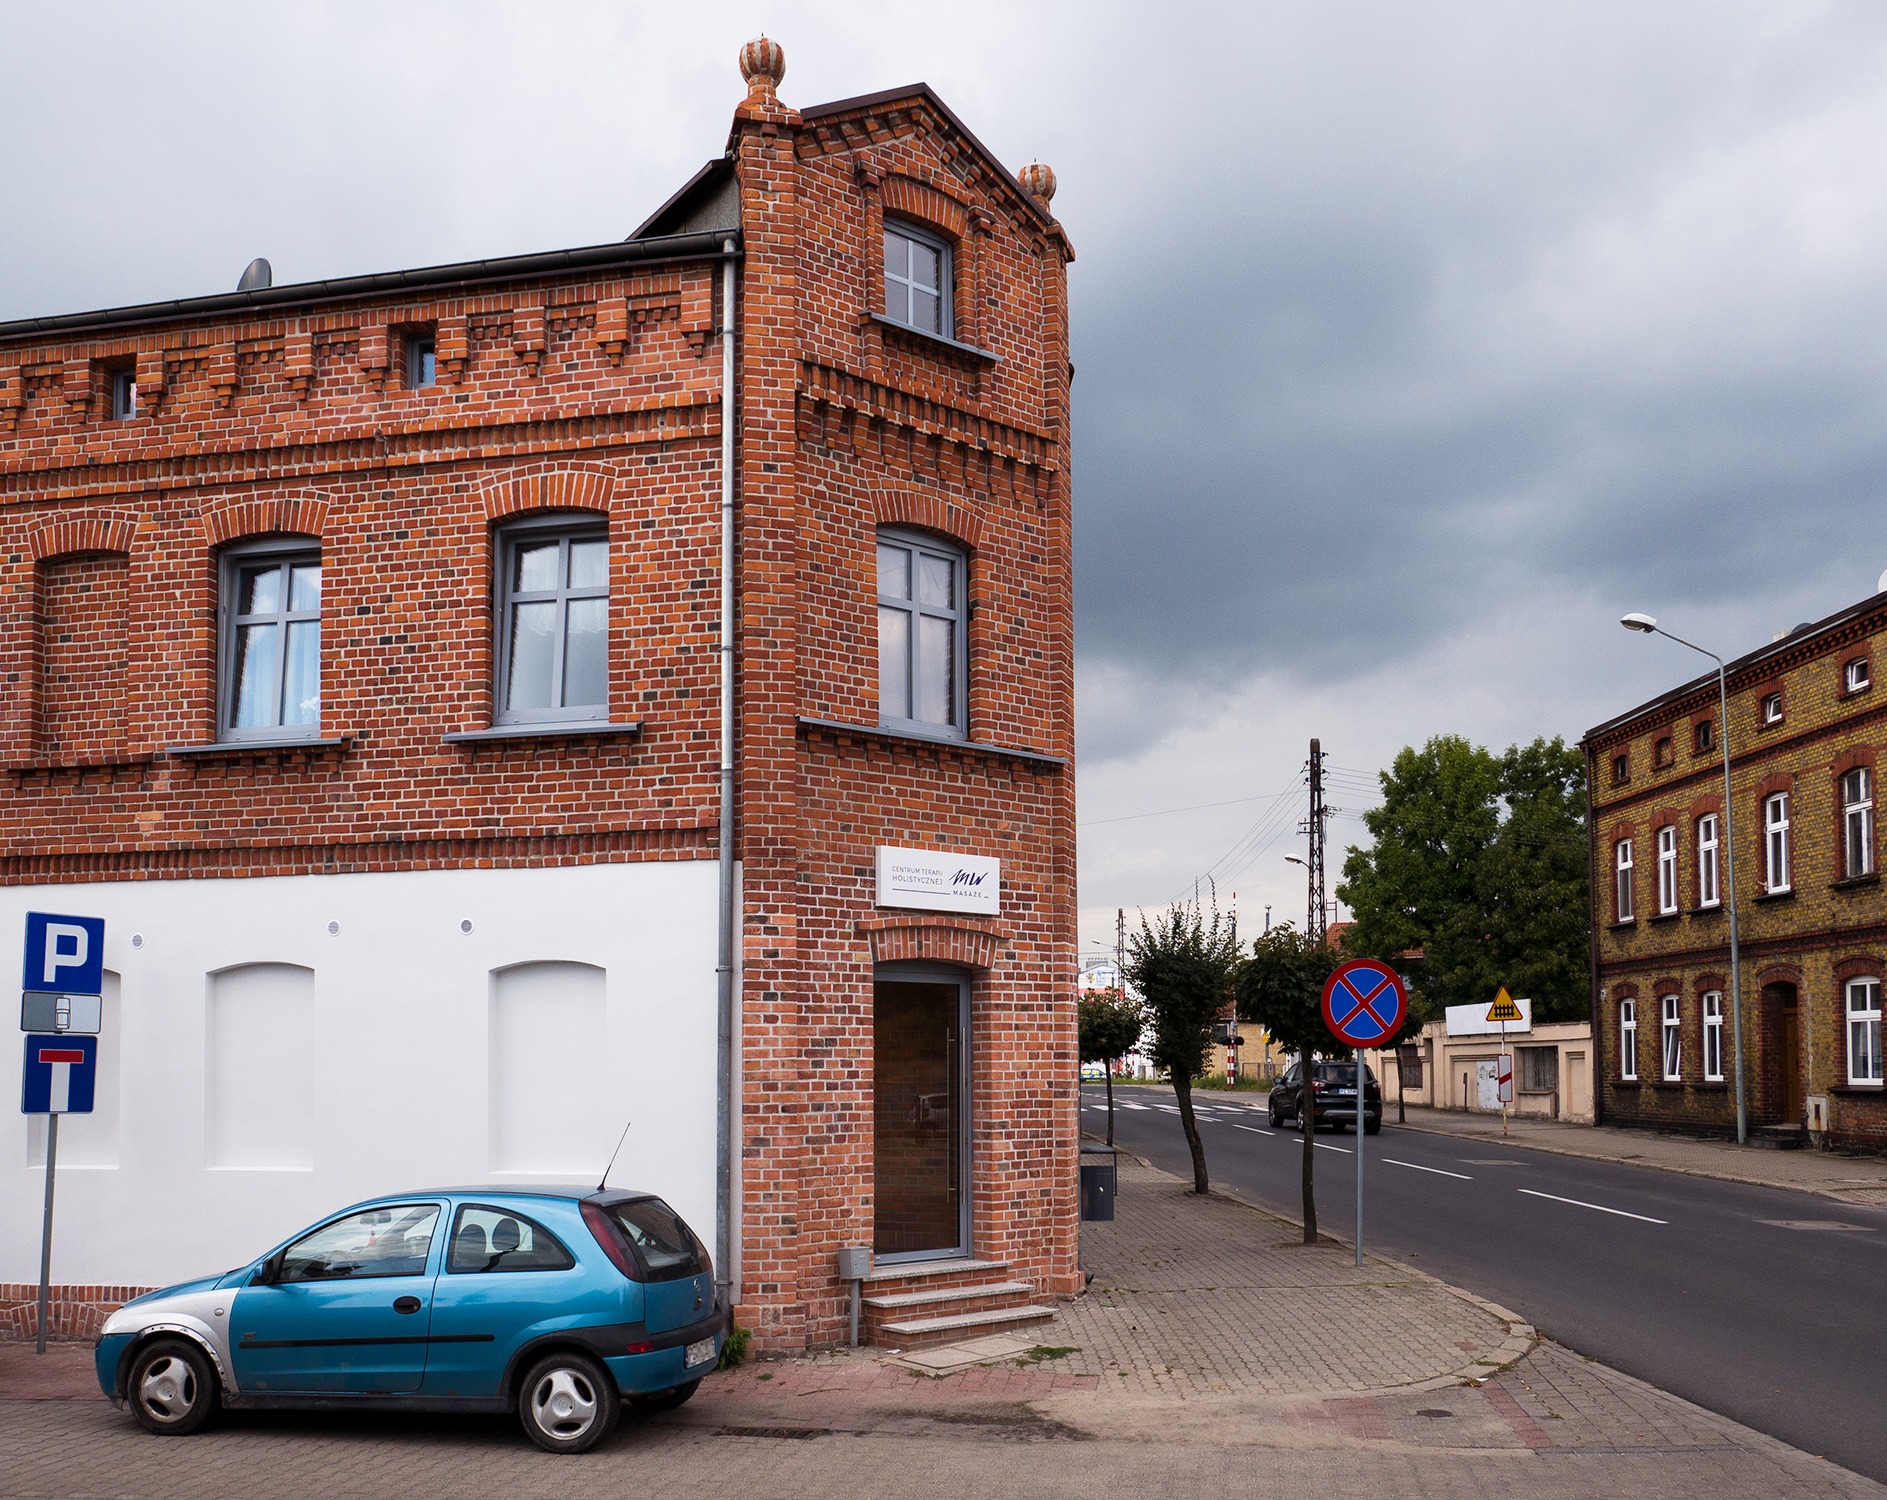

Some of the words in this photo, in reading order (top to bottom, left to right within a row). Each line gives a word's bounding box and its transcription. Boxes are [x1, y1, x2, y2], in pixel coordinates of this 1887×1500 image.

[891, 865, 921, 875] CENTRUM
[892, 874, 943, 886] HOLISTYCZNEJ
[43, 922, 89, 983] P
